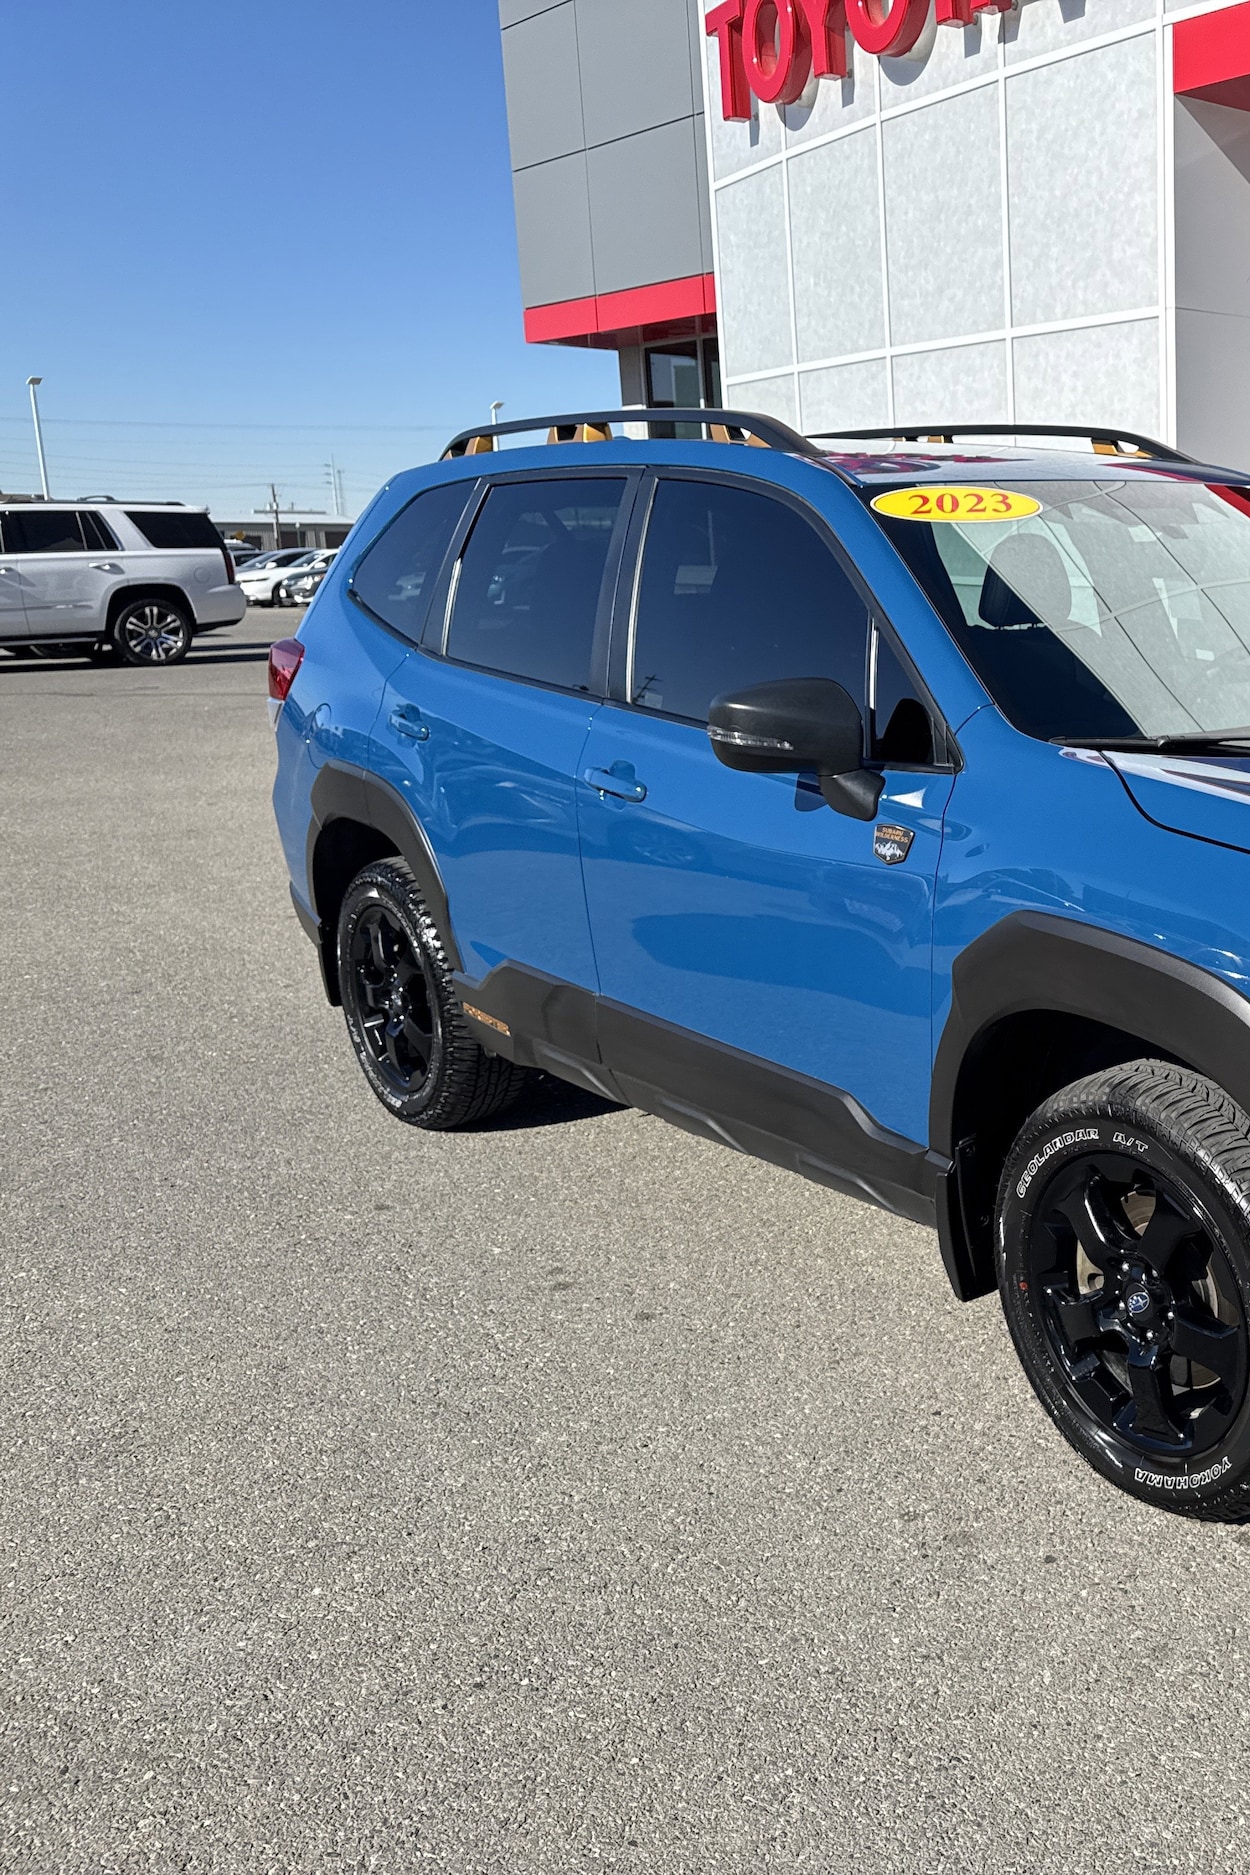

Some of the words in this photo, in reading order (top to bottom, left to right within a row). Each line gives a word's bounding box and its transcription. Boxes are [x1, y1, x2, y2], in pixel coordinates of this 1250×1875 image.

[705, 0, 1013, 122] TOYO
[908, 492, 1012, 515] 2023
[1016, 1128, 1100, 1198] GEOLANDAR
[1112, 1131, 1149, 1152] A/T
[1134, 1456, 1232, 1489] YOKOHAMA
